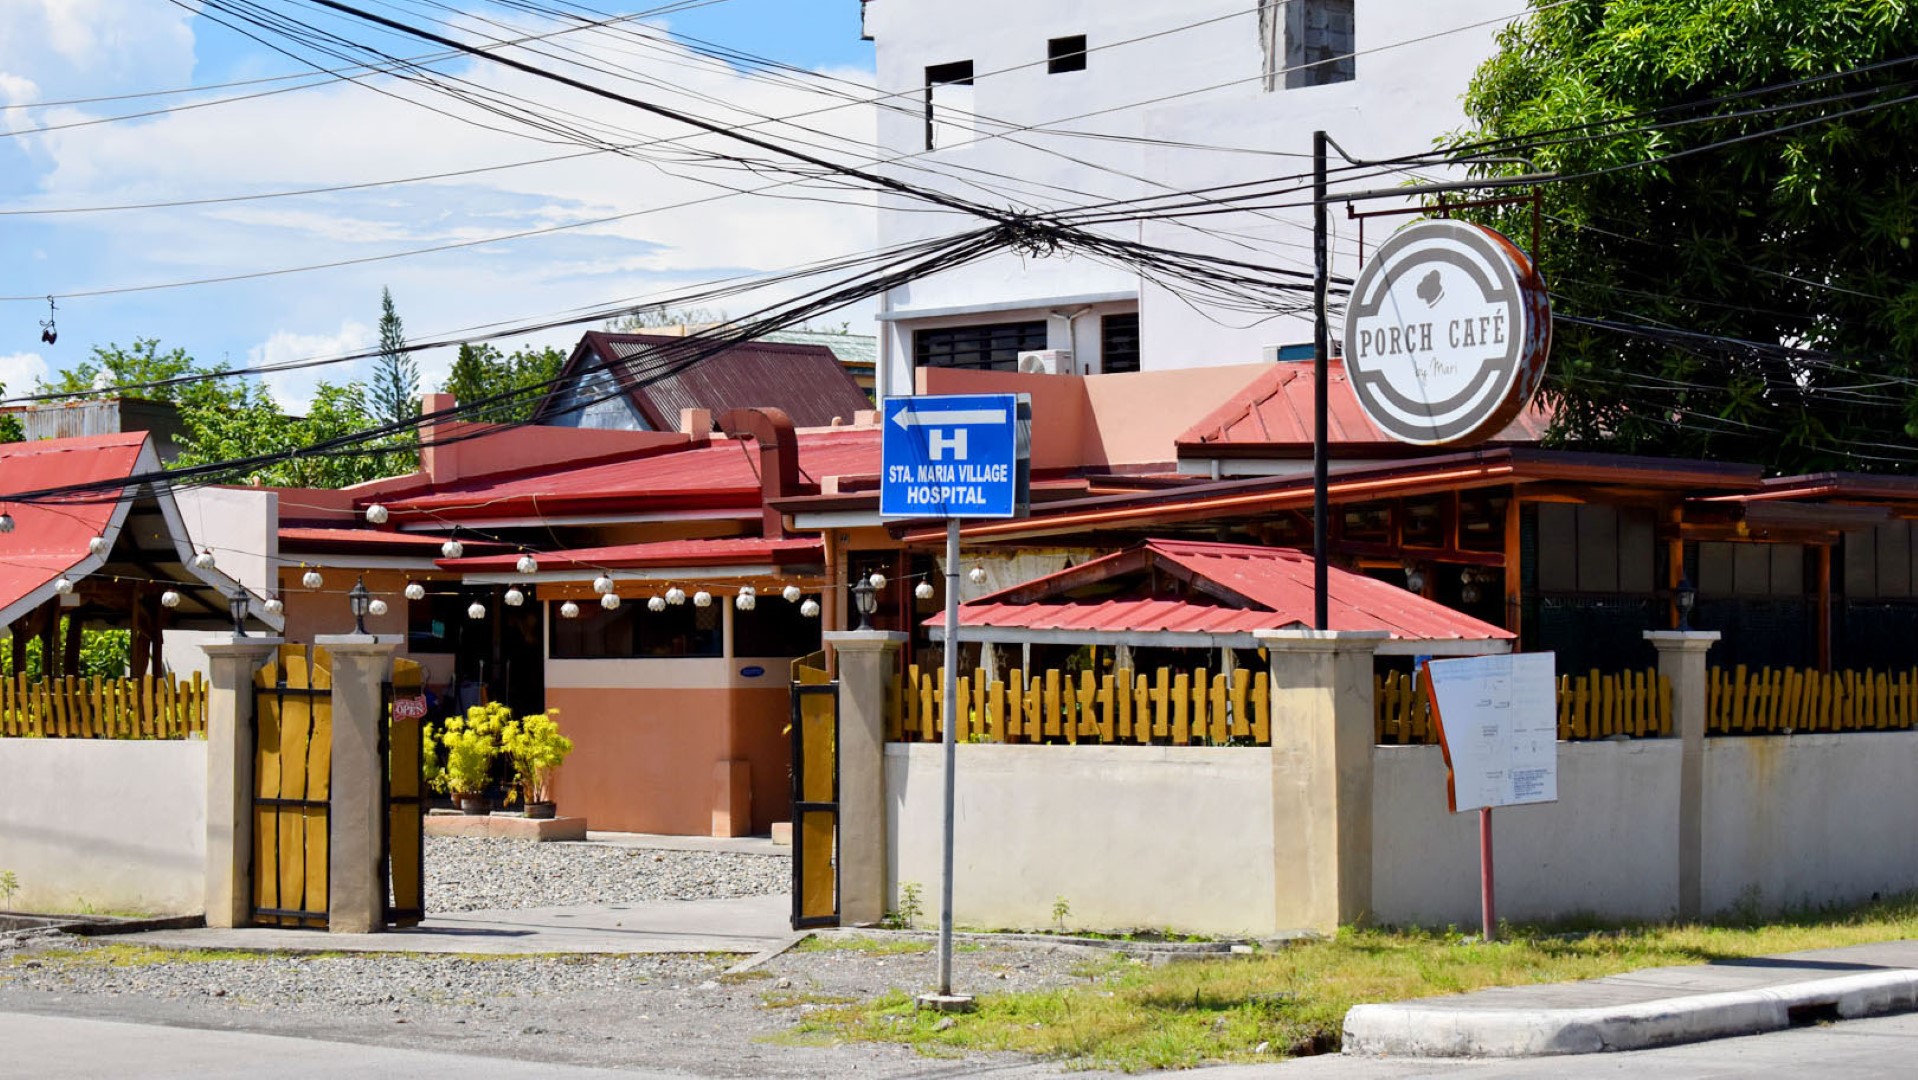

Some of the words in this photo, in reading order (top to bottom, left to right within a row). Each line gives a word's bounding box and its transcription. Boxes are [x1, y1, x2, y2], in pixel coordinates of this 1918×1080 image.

[1360, 323, 1433, 358] PORCH
[1448, 309, 1504, 349] CAFÉ
[929, 428, 968, 461] H
[889, 465, 914, 483] STA.
[917, 464, 955, 483] MARIA
[959, 464, 1008, 482] VILLAGE
[907, 486, 987, 504] HOSPITAL
[395, 703, 423, 716] OPEN
